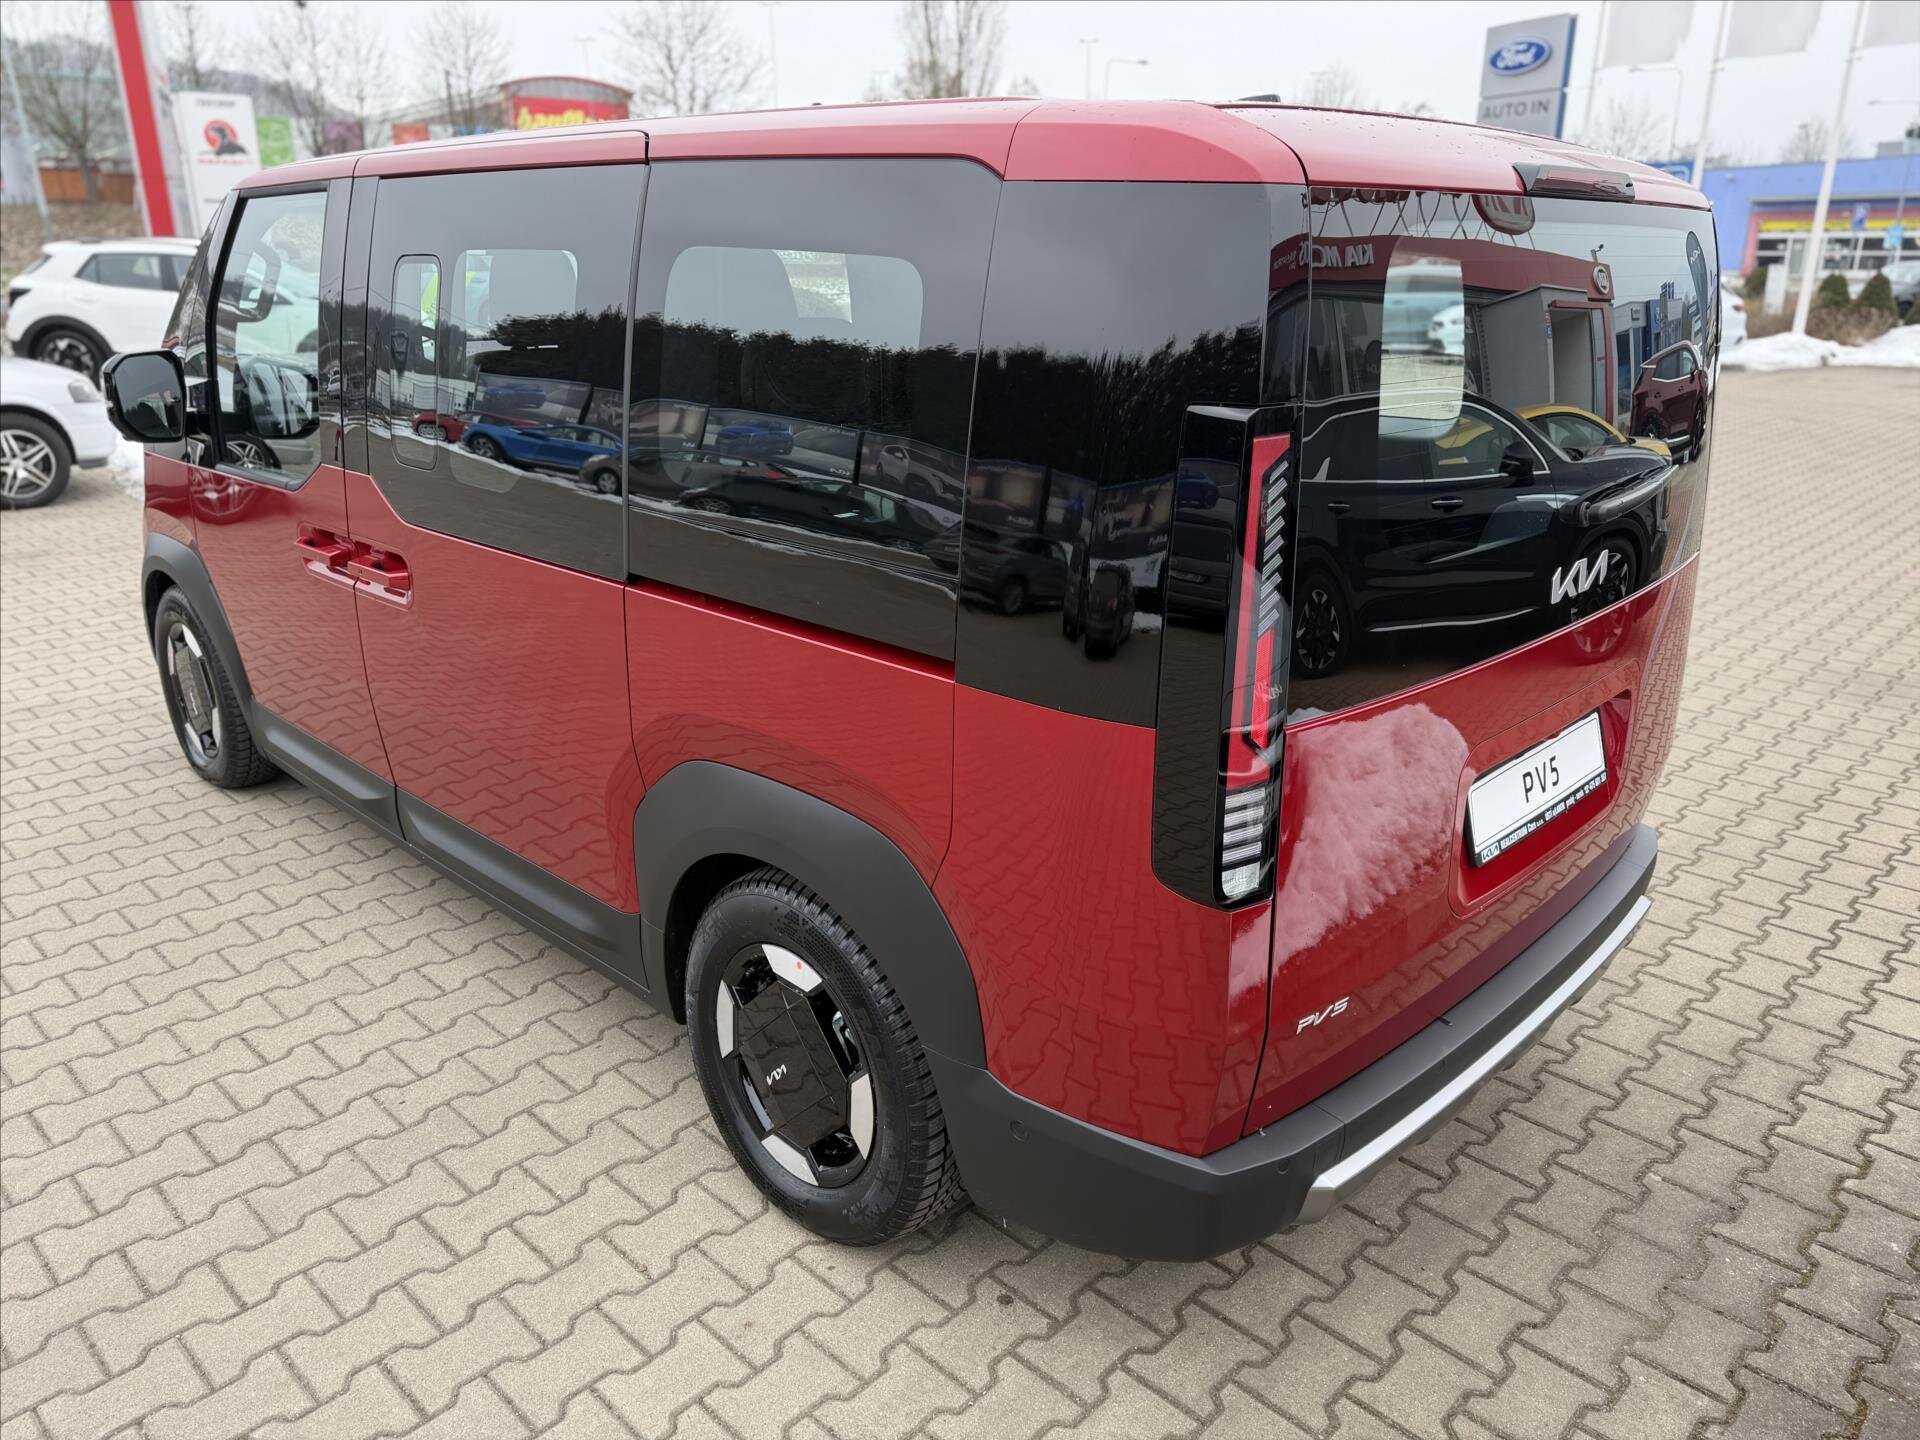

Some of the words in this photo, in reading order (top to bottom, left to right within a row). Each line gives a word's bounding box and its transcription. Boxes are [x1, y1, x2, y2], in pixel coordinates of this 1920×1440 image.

[1496, 43, 1538, 69] Ford
[1482, 101, 1528, 119] AUTO
[1529, 99, 1551, 115] IN
[1550, 548, 1609, 605] KIA
[1522, 755, 1560, 803] PV5
[1296, 996, 1350, 1035] PV5
